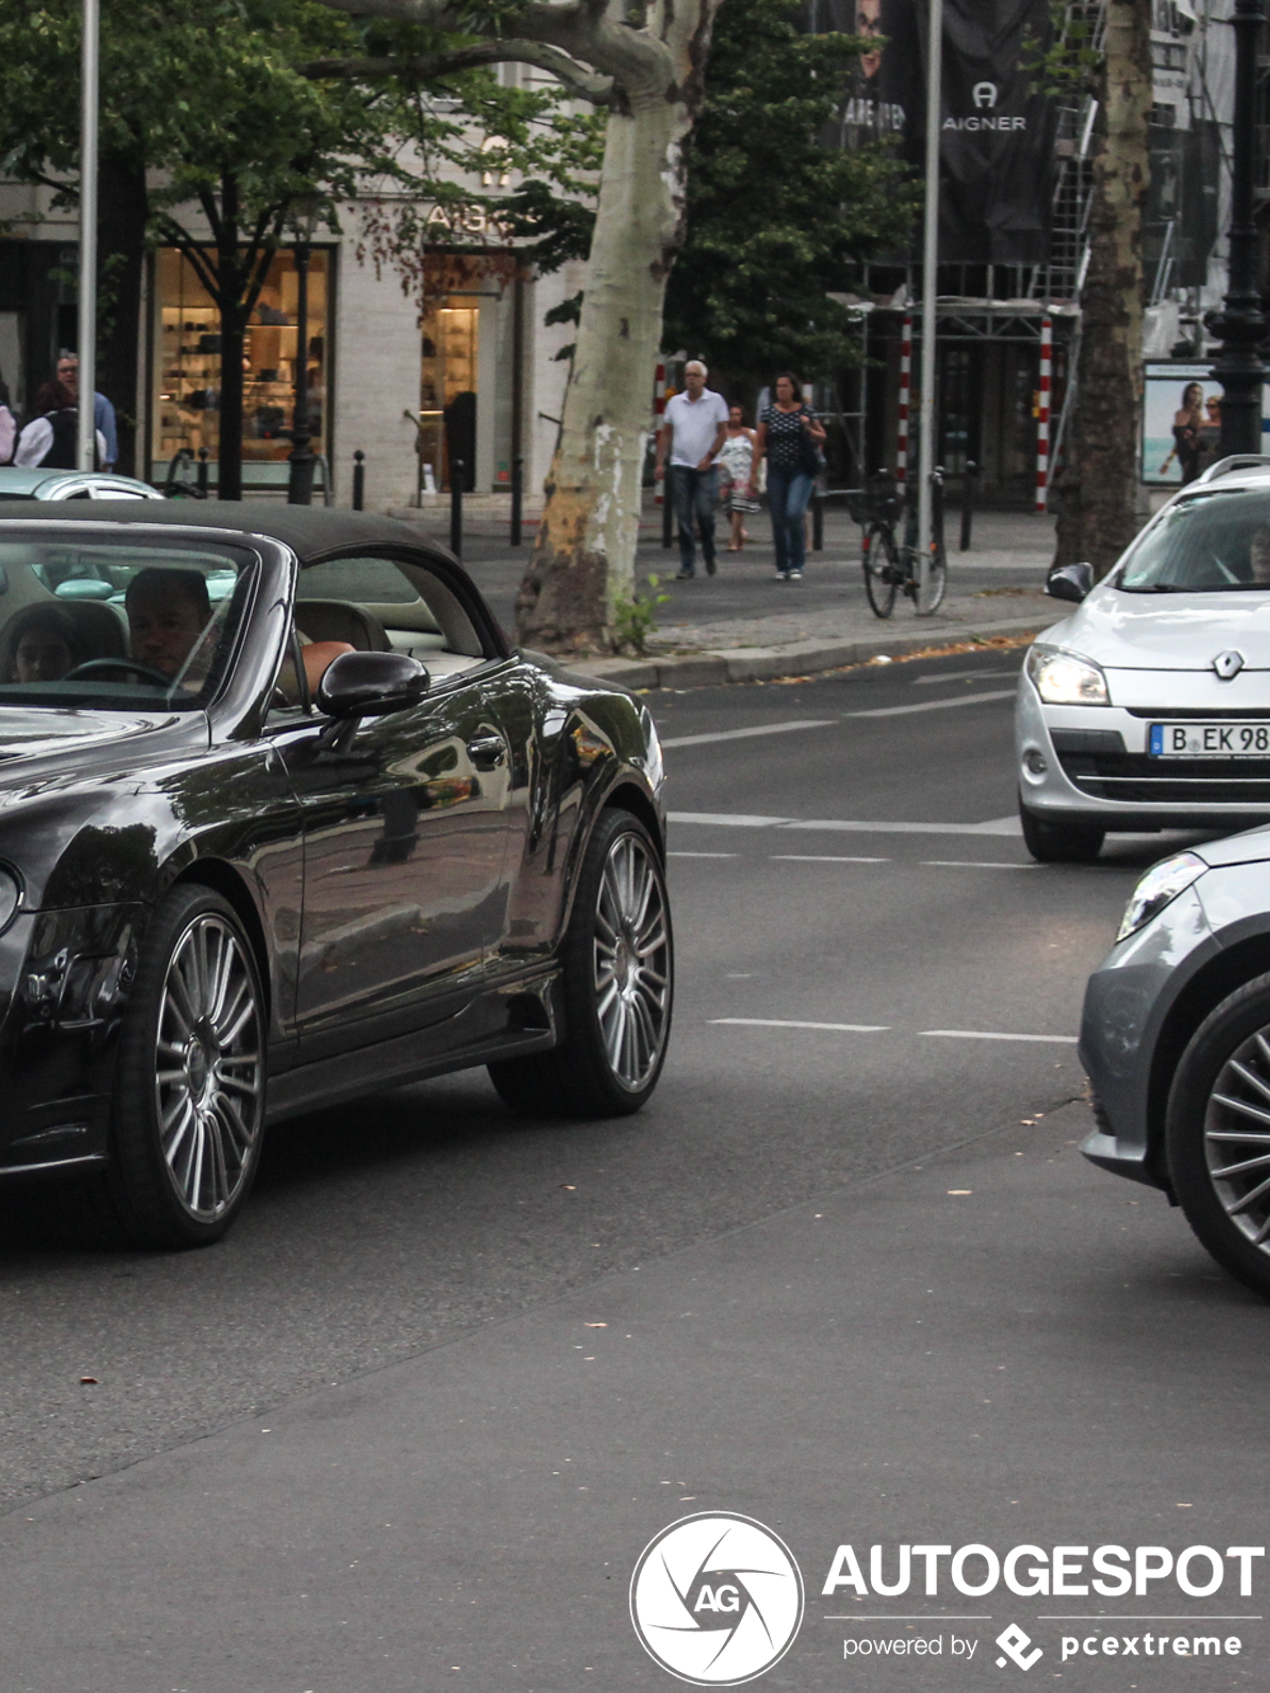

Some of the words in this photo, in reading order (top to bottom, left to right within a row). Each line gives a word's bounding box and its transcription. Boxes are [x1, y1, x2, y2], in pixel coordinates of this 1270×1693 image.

[941, 116, 1027, 131] AIGNER
[1172, 728, 1187, 751] B
[1203, 728, 1234, 751] EK
[1240, 727, 1269, 751] 98
